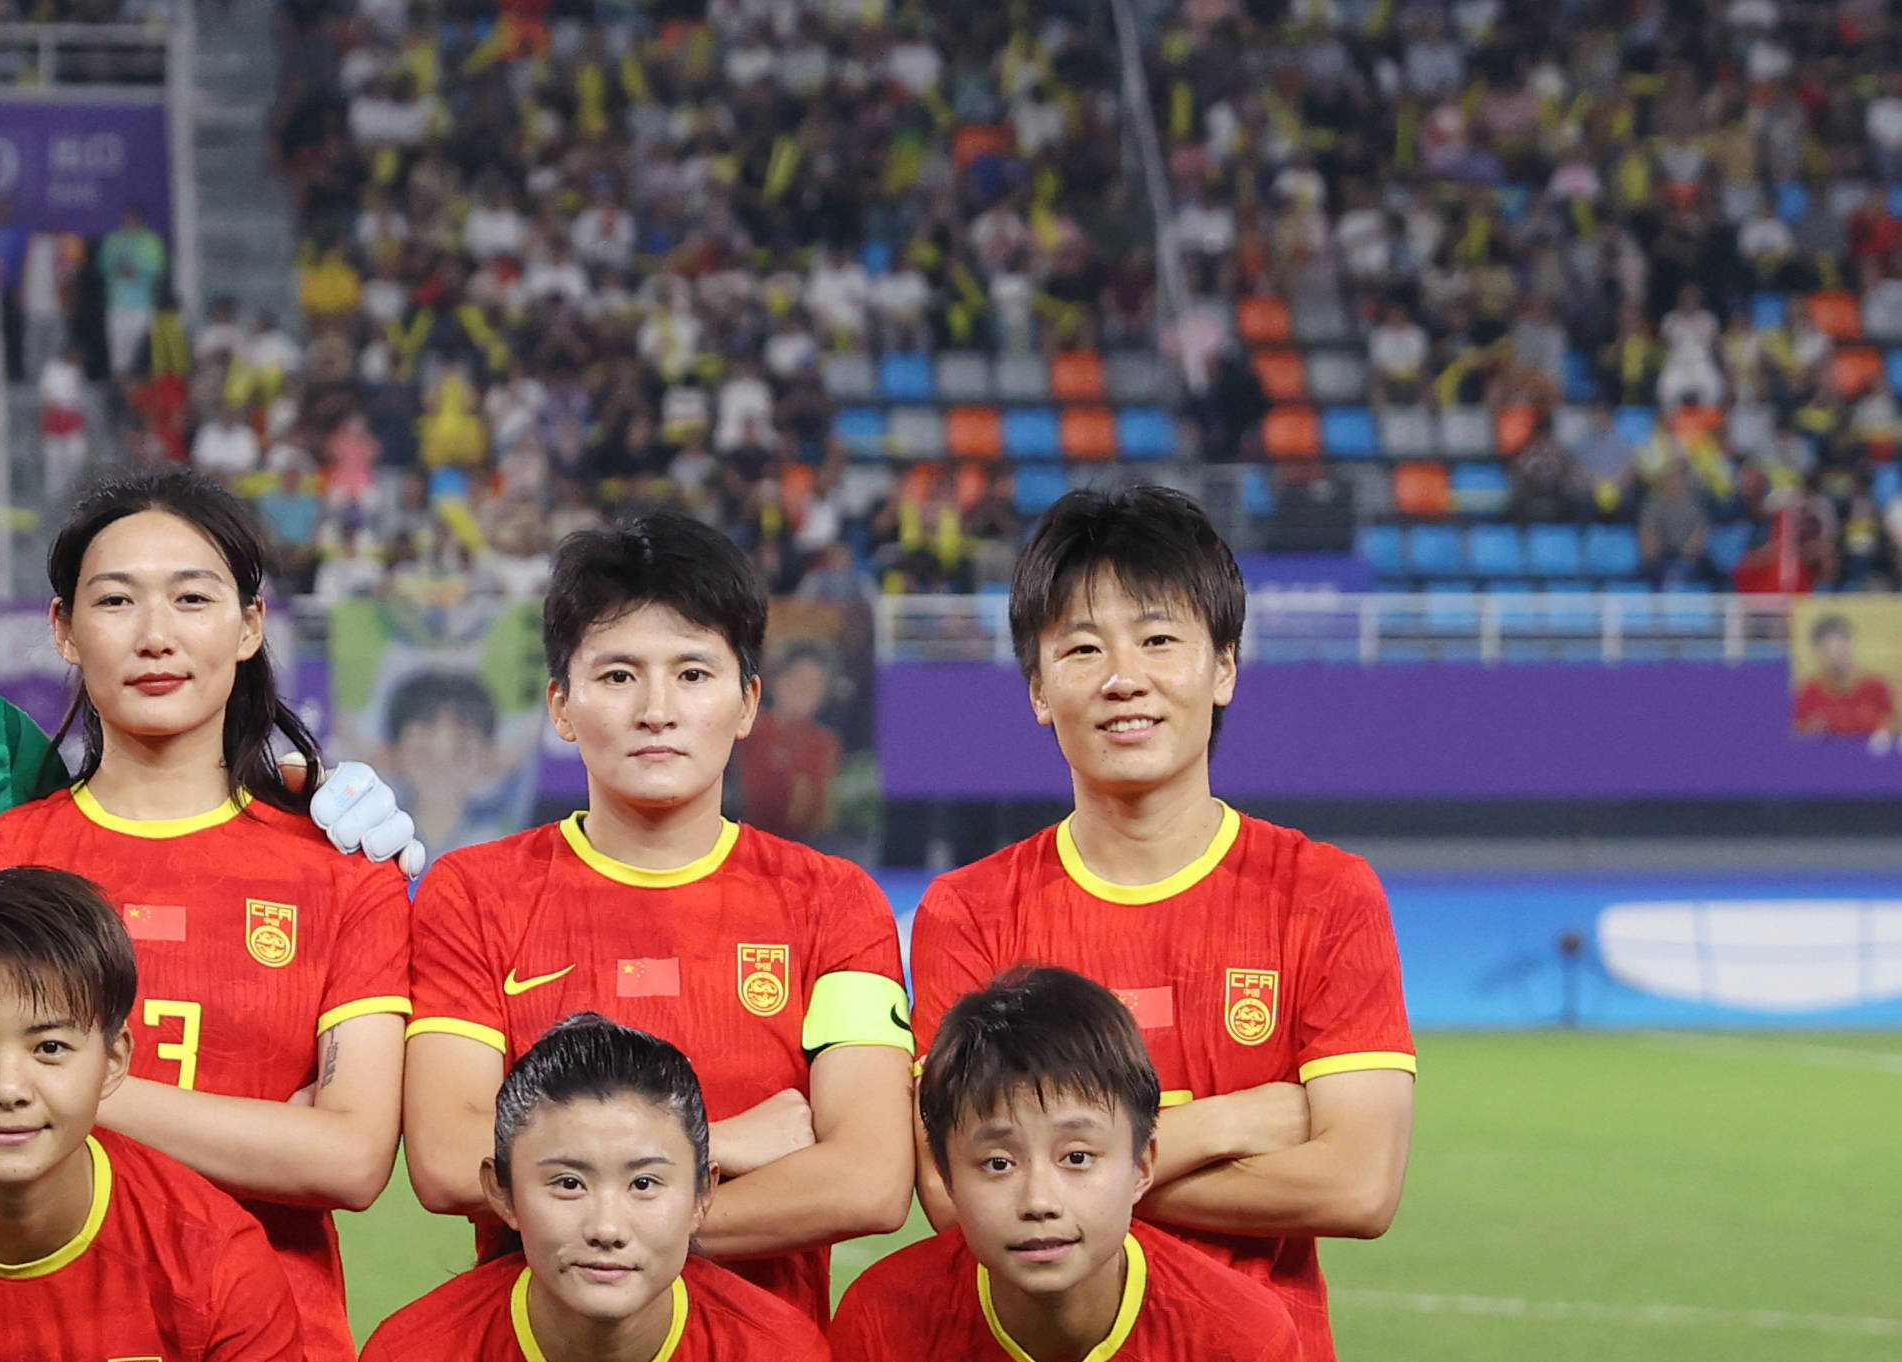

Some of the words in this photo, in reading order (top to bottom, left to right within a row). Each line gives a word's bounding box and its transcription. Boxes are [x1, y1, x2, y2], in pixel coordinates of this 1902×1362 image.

[251, 903, 292, 921] CFA
[742, 948, 784, 963] CFA
[1231, 973, 1274, 990] CFA
[143, 999, 202, 1091] 3
